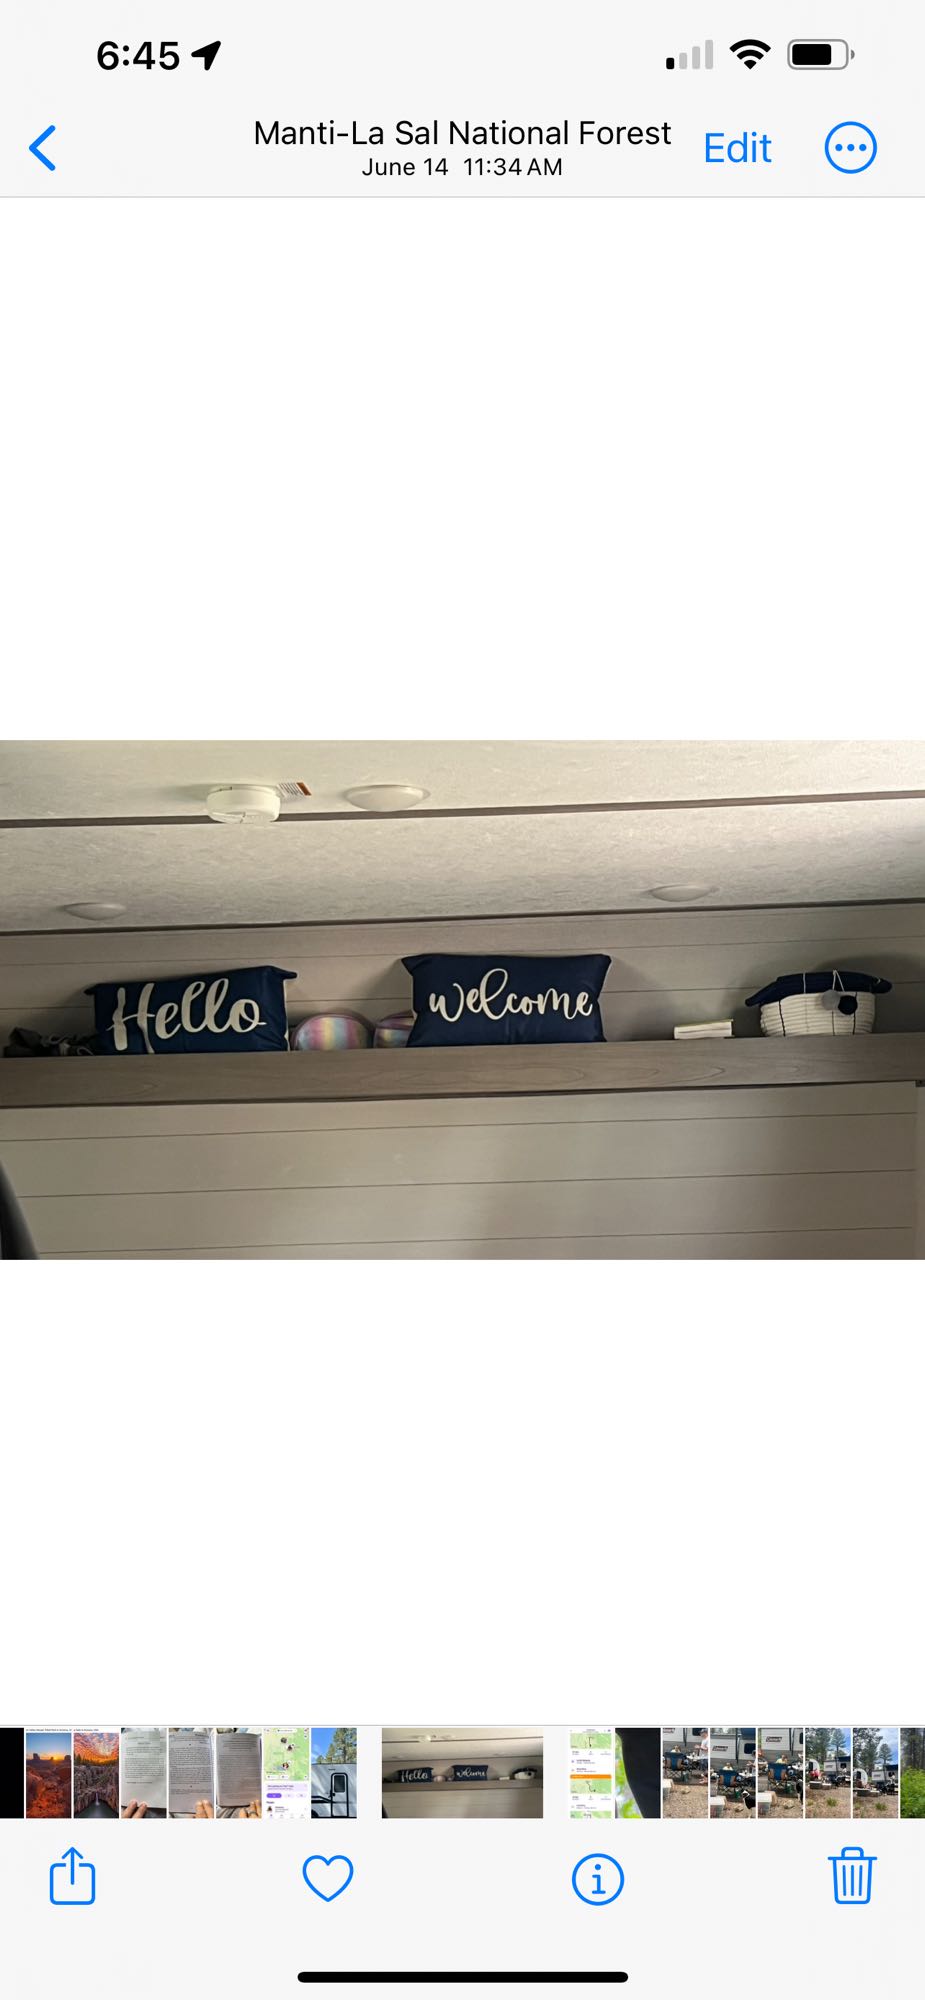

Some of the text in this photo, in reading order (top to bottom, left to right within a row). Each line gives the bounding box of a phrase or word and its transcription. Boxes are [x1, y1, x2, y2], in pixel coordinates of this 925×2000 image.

[97, 41, 180, 71] 6:45
[255, 119, 672, 146] Manti-La Sal National Forest
[705, 131, 772, 164] Edit
[362, 157, 562, 177] June 14 11:34 AM
[429, 968, 593, 1022] welcome
[106, 978, 267, 1054] Hello
